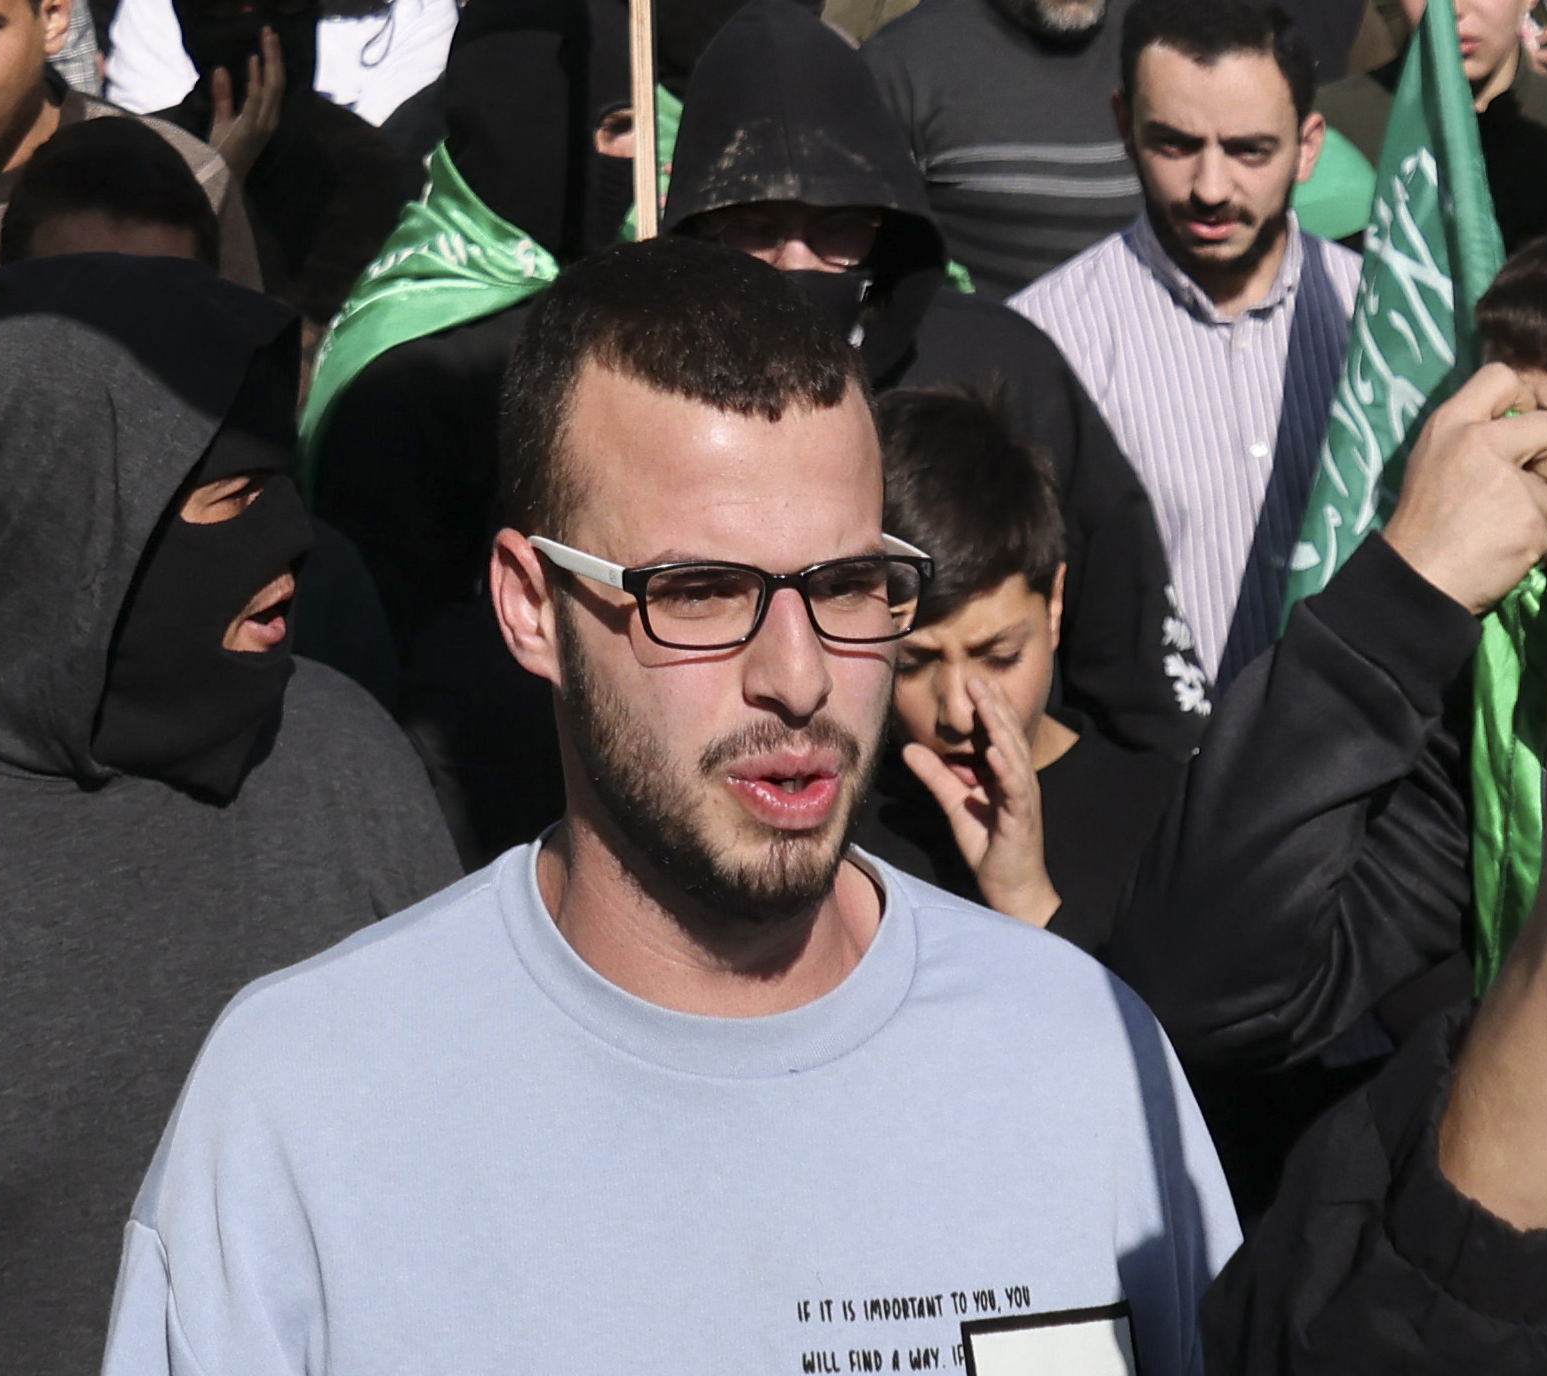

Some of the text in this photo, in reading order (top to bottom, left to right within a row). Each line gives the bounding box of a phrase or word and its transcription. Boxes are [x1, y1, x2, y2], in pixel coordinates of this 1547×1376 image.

[797, 1285, 1031, 1322] IF IT IS IMPORTANT TO YOU, YOU
[802, 1344, 965, 1374] WILL FIND A WAY. IF
